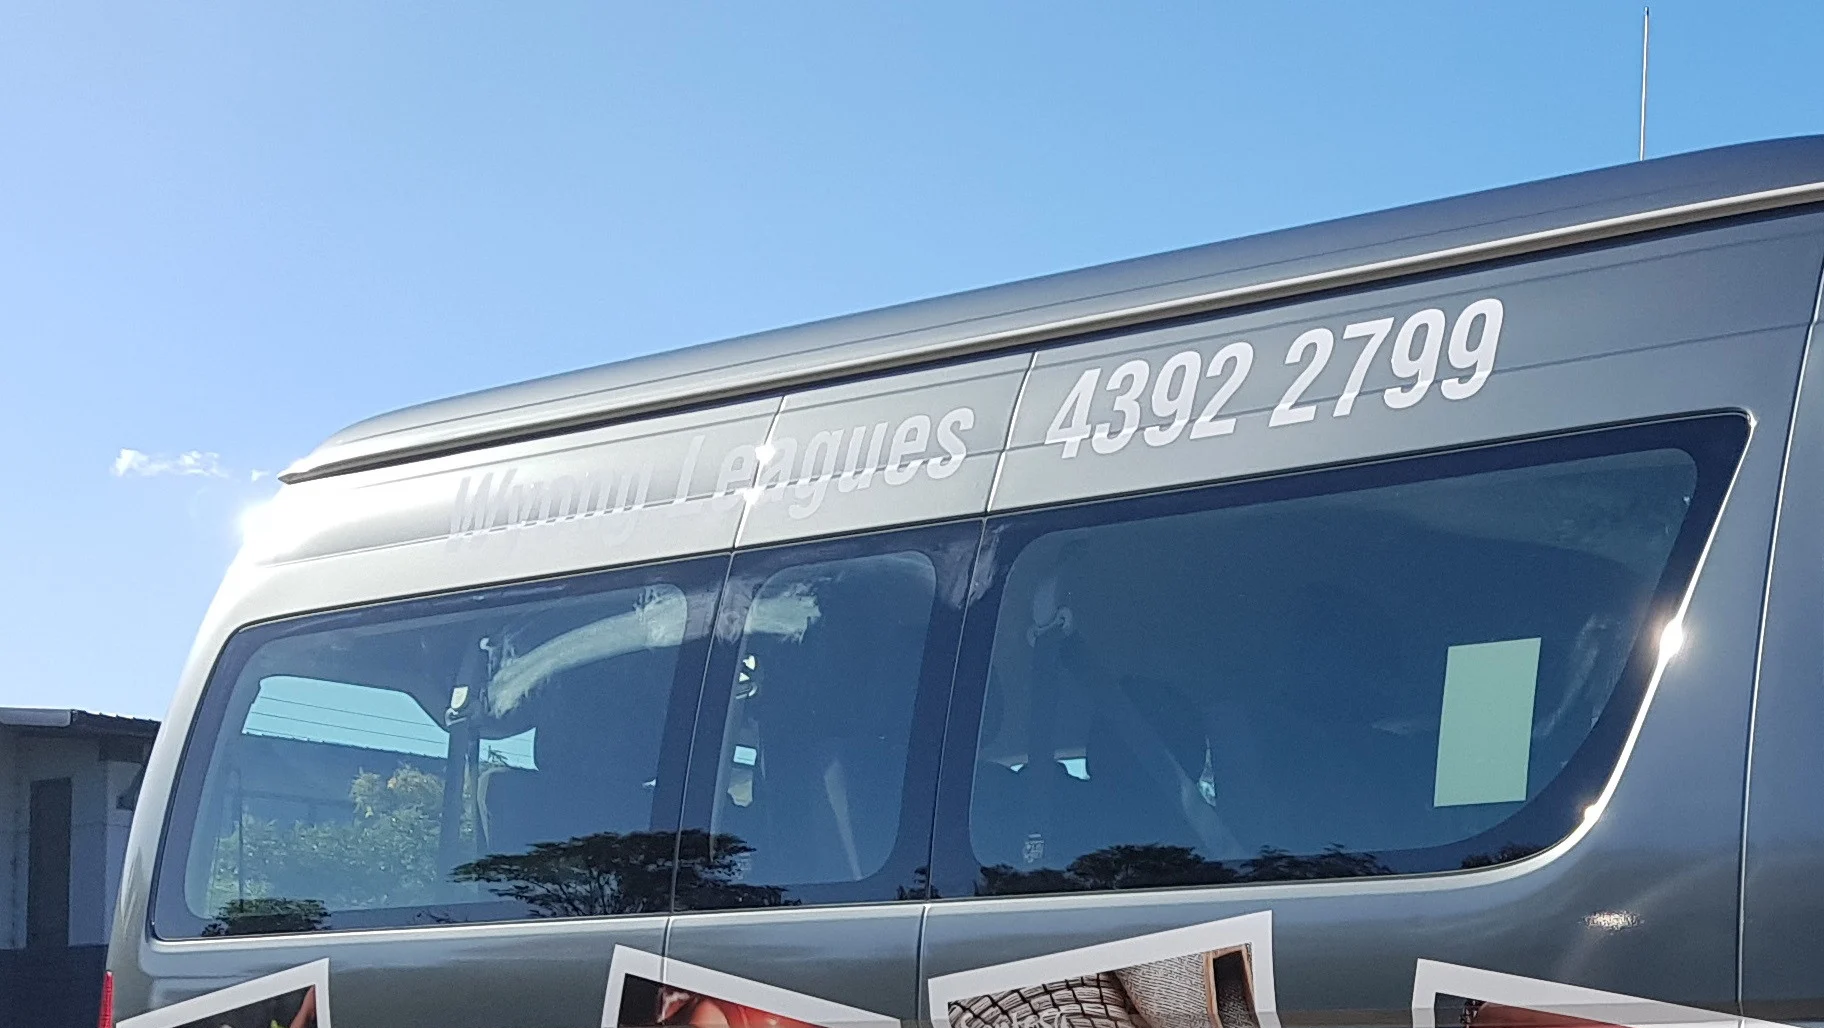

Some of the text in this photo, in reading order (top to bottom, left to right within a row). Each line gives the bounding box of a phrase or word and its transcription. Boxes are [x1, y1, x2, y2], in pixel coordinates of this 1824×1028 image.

[667, 406, 975, 520] Leagues
[1044, 342, 1254, 459] 4392
[1268, 298, 1504, 428] 2799
